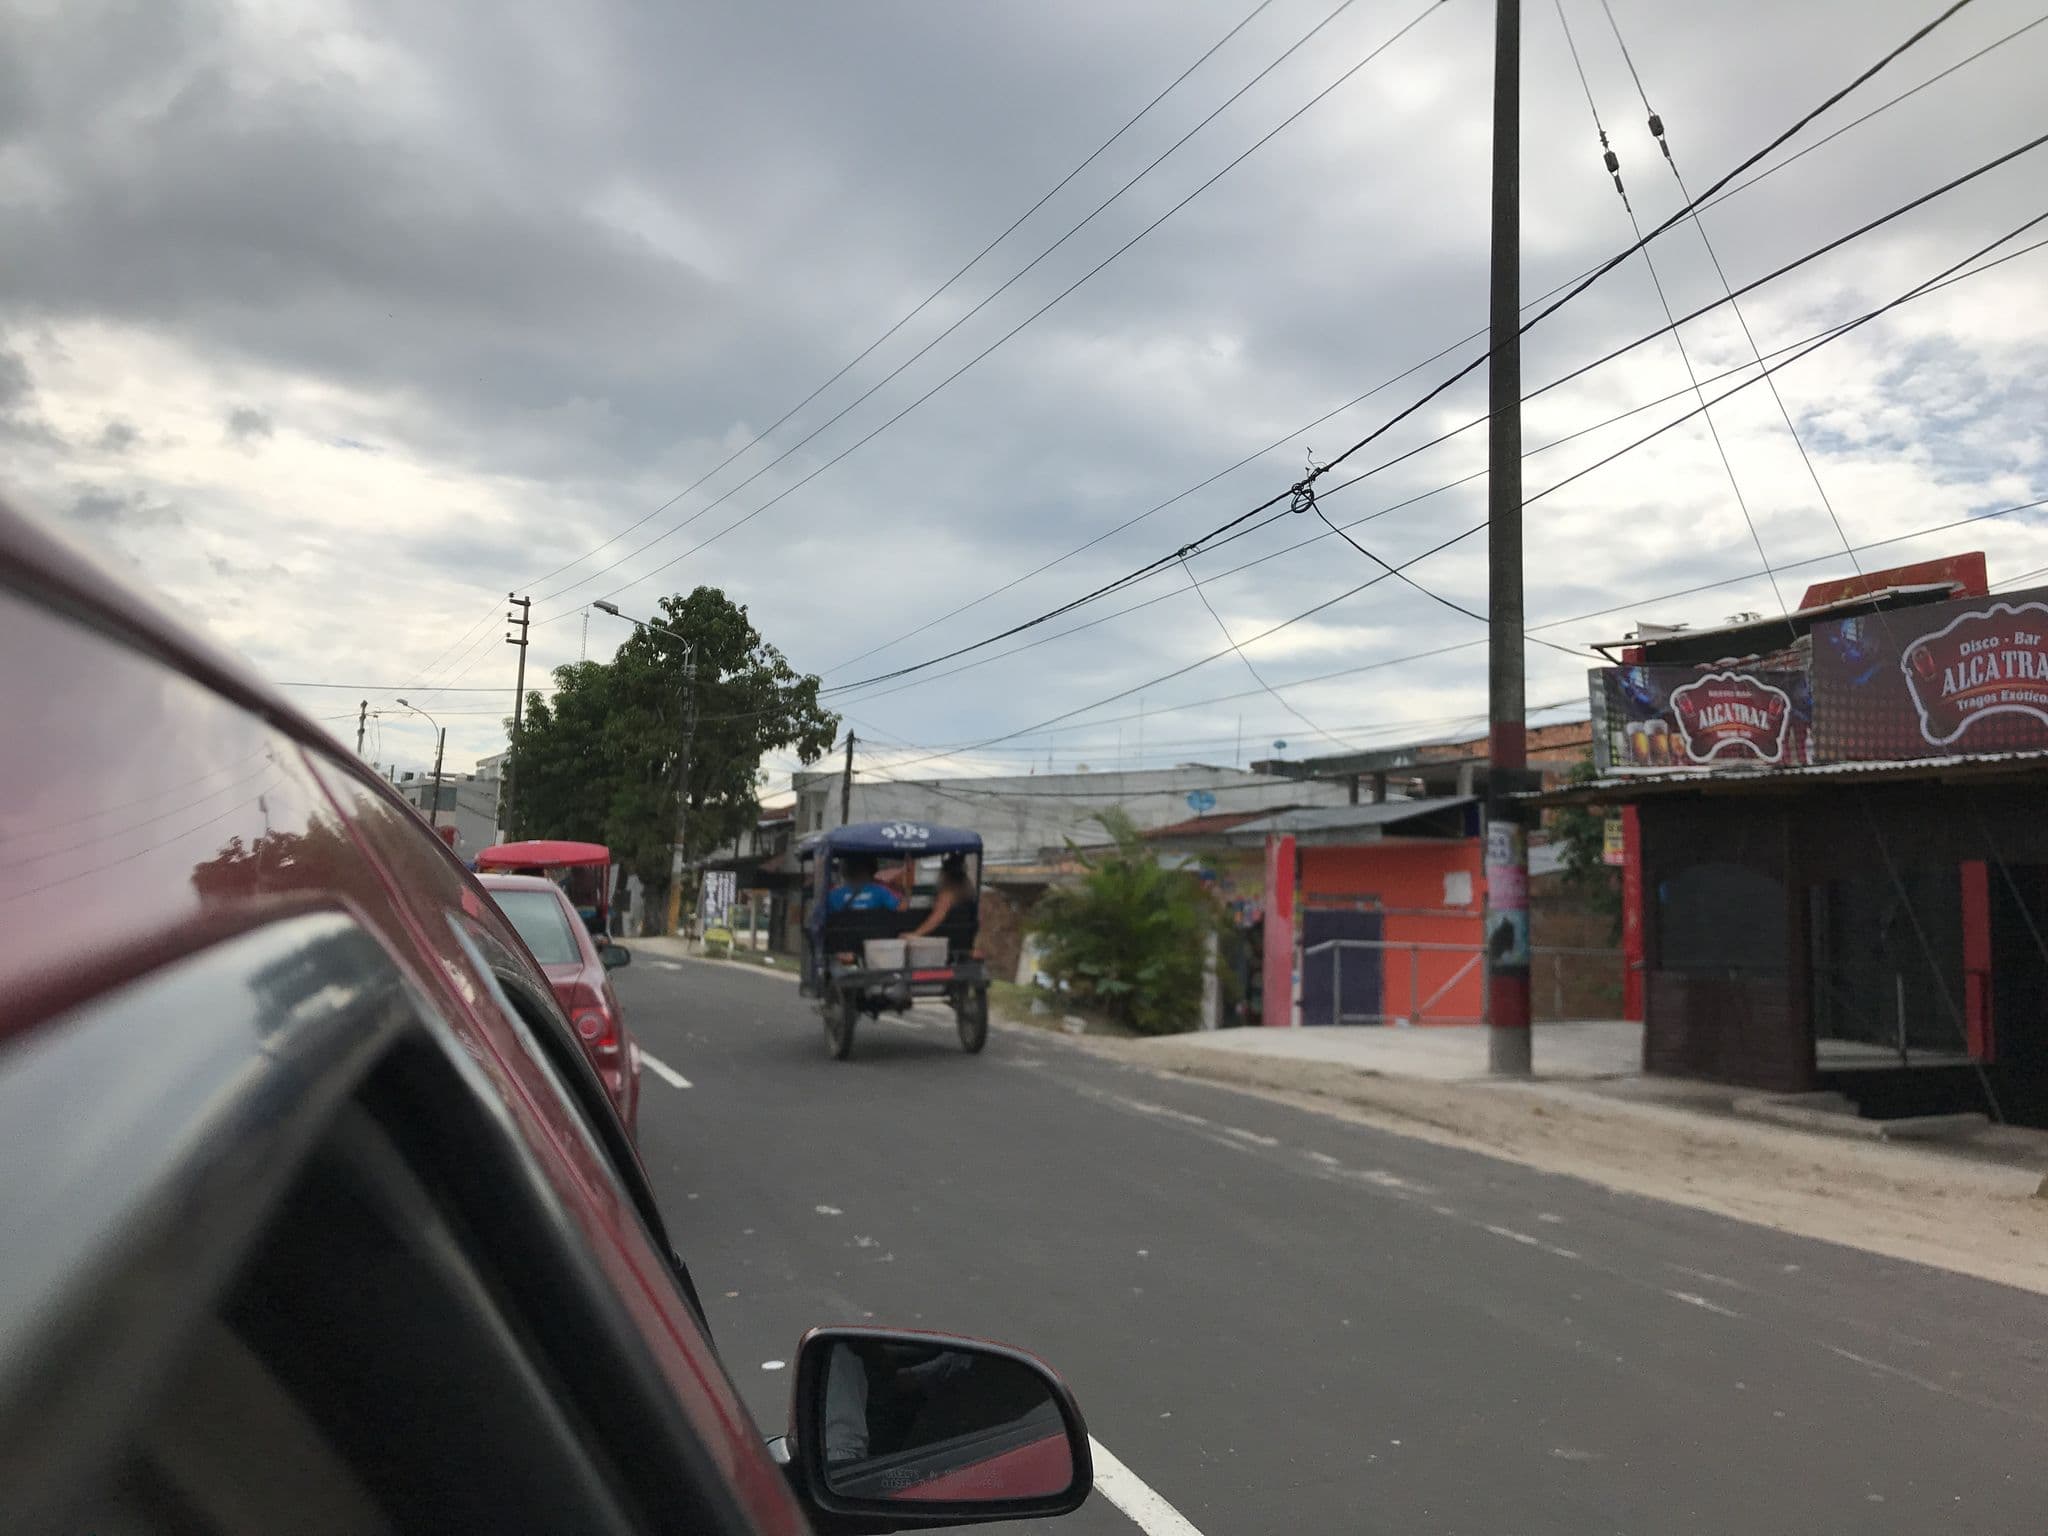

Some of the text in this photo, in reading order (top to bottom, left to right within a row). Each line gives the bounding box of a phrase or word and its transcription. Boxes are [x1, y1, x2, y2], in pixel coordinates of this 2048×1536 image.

[1960, 631, 2041, 656] Disco Bar
[1957, 689, 2048, 711] Tragos Exótico
[1698, 702, 1770, 730] ALCATRAZ
